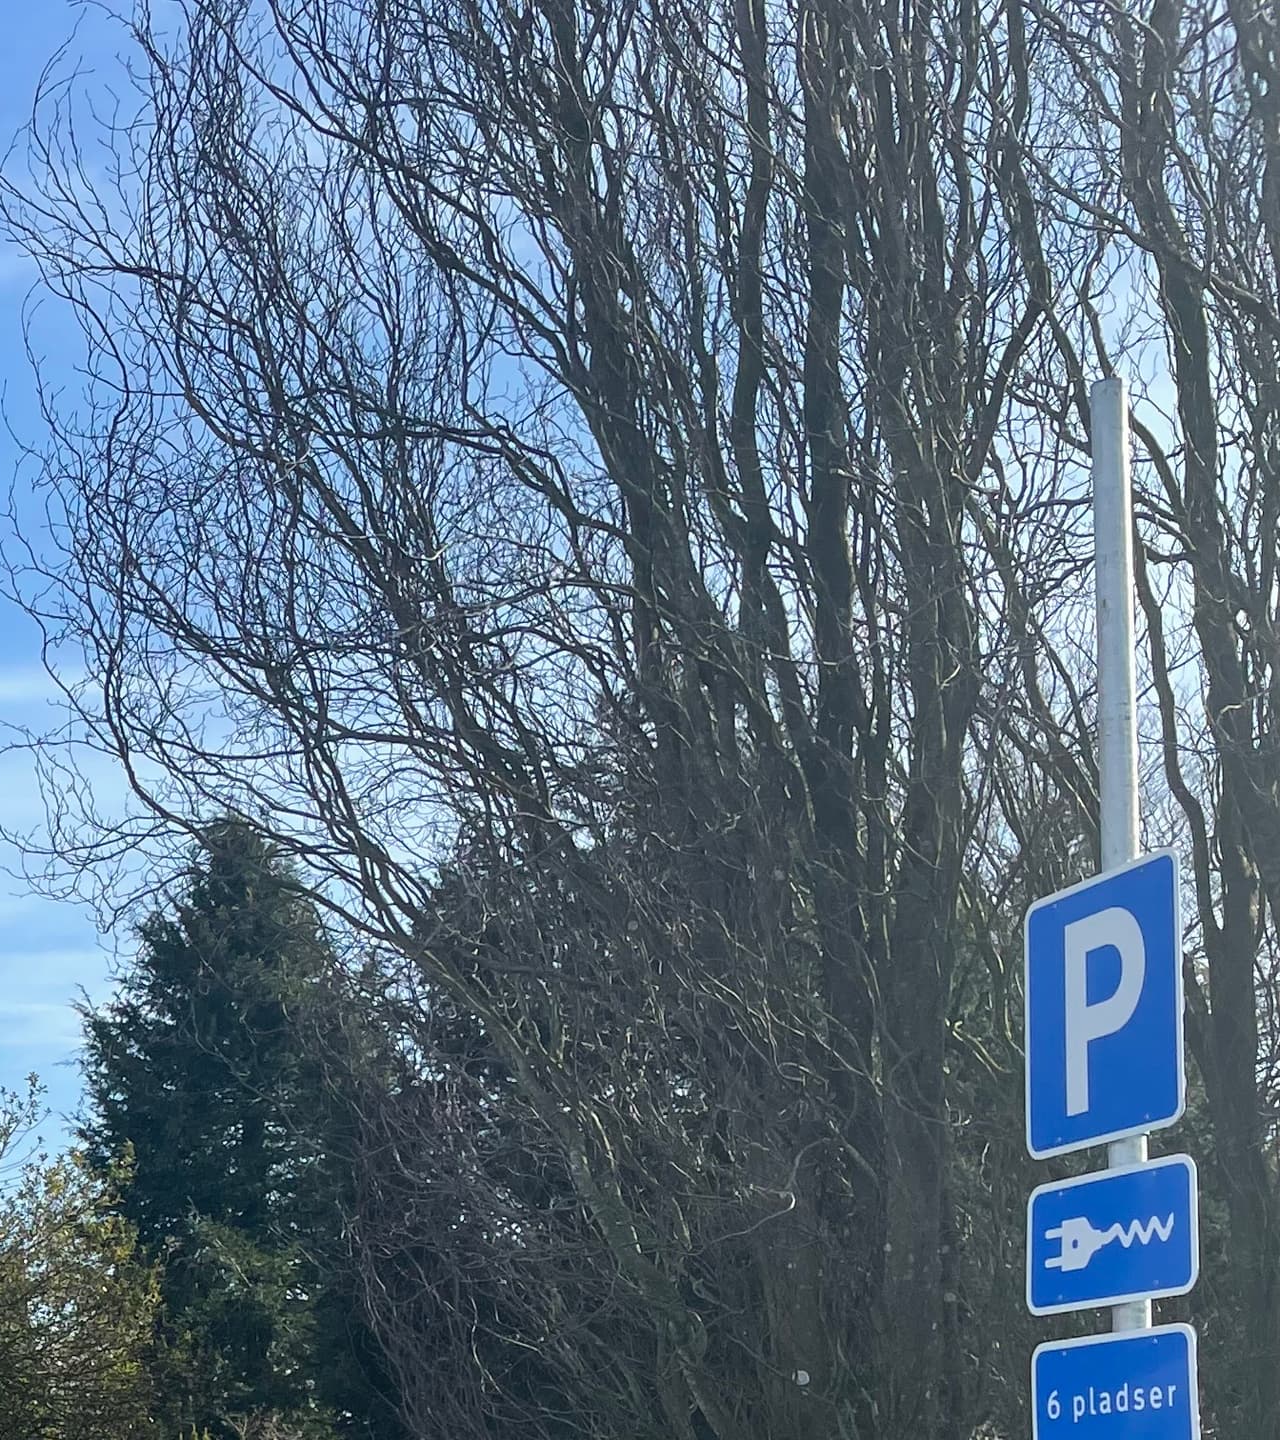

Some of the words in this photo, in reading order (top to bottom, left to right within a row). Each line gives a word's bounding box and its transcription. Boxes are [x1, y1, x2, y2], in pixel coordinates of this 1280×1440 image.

[1064, 906, 1146, 1117] P
[1047, 1388, 1061, 1420] 6
[1072, 1382, 1177, 1423] pladser
